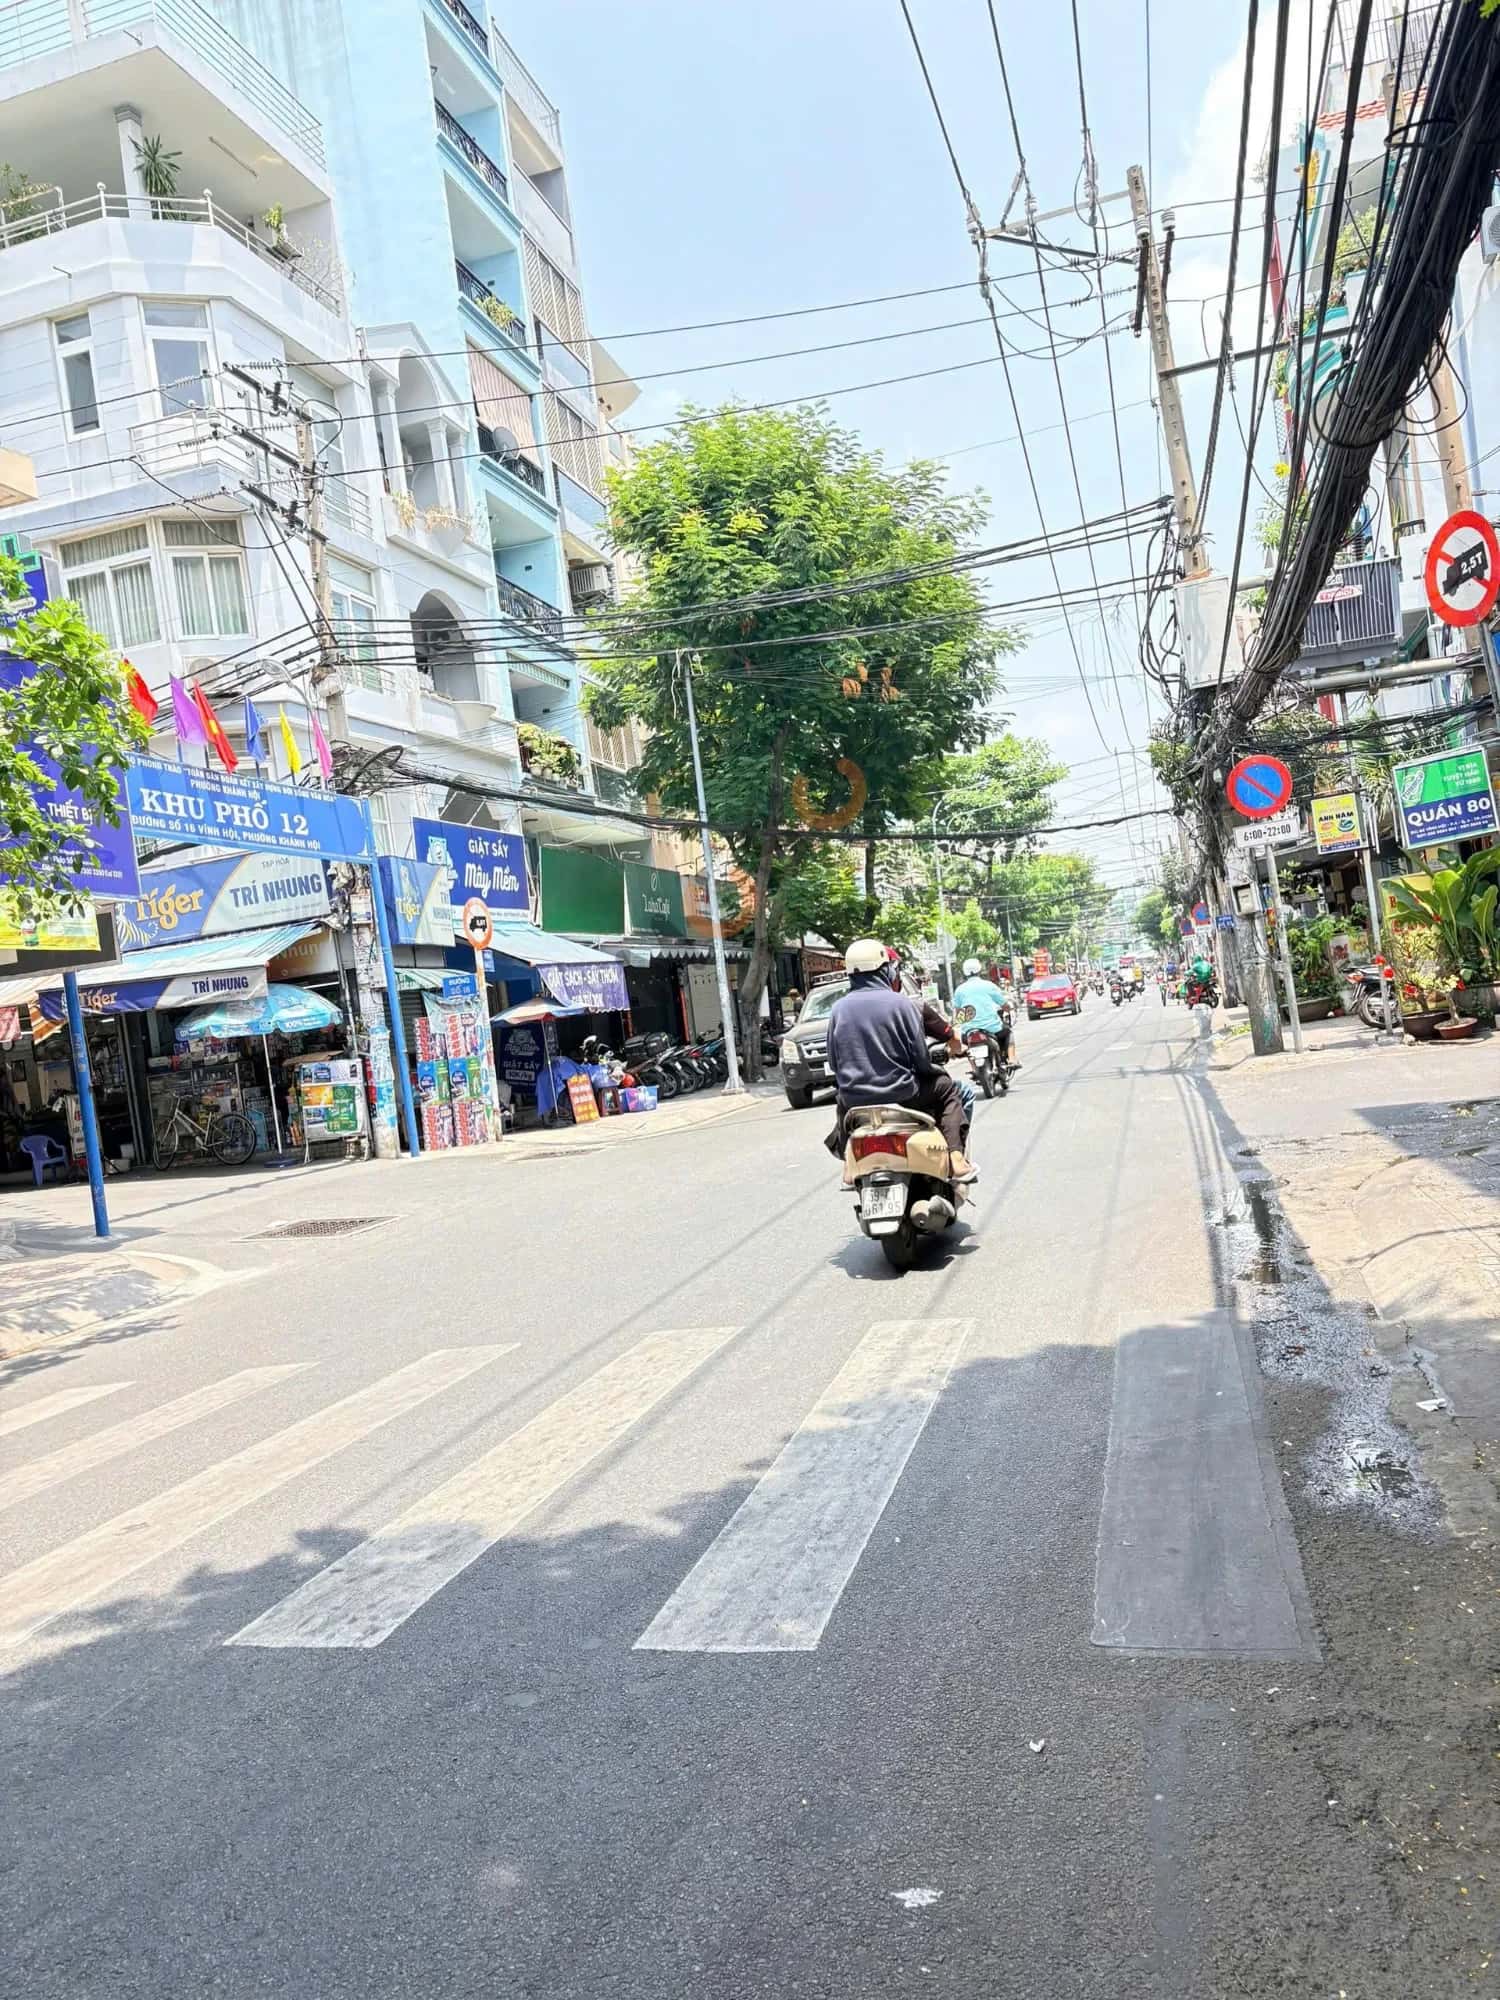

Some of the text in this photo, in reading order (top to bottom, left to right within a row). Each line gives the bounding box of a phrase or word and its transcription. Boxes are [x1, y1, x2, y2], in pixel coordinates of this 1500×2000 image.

[1461, 551, 1482, 574] 2,5T
[47, 799, 79, 819] THIẾT
[140, 787, 309, 836] KHU PHỐ 12
[1407, 797, 1491, 827] QUÁN 80
[131, 815, 166, 829] ĐƯỜNG
[169, 819, 181, 831] SỐ
[198, 823, 220, 837] VĨNH
[242, 831, 277, 844] PHƯỜNG
[279, 835, 306, 848] KHÁNH
[307, 839, 320, 851] HỘI
[1243, 823, 1291, 841] 6:00-22:00
[468, 837, 509, 859] GIẶT SẤY
[229, 873, 322, 908] TRÍ NHUNG
[464, 862, 519, 898] Mây Mềm
[136, 884, 204, 929] Tiger
[192, 975, 249, 994] TRÍ NHUNG
[79, 987, 117, 1011] Tiger
